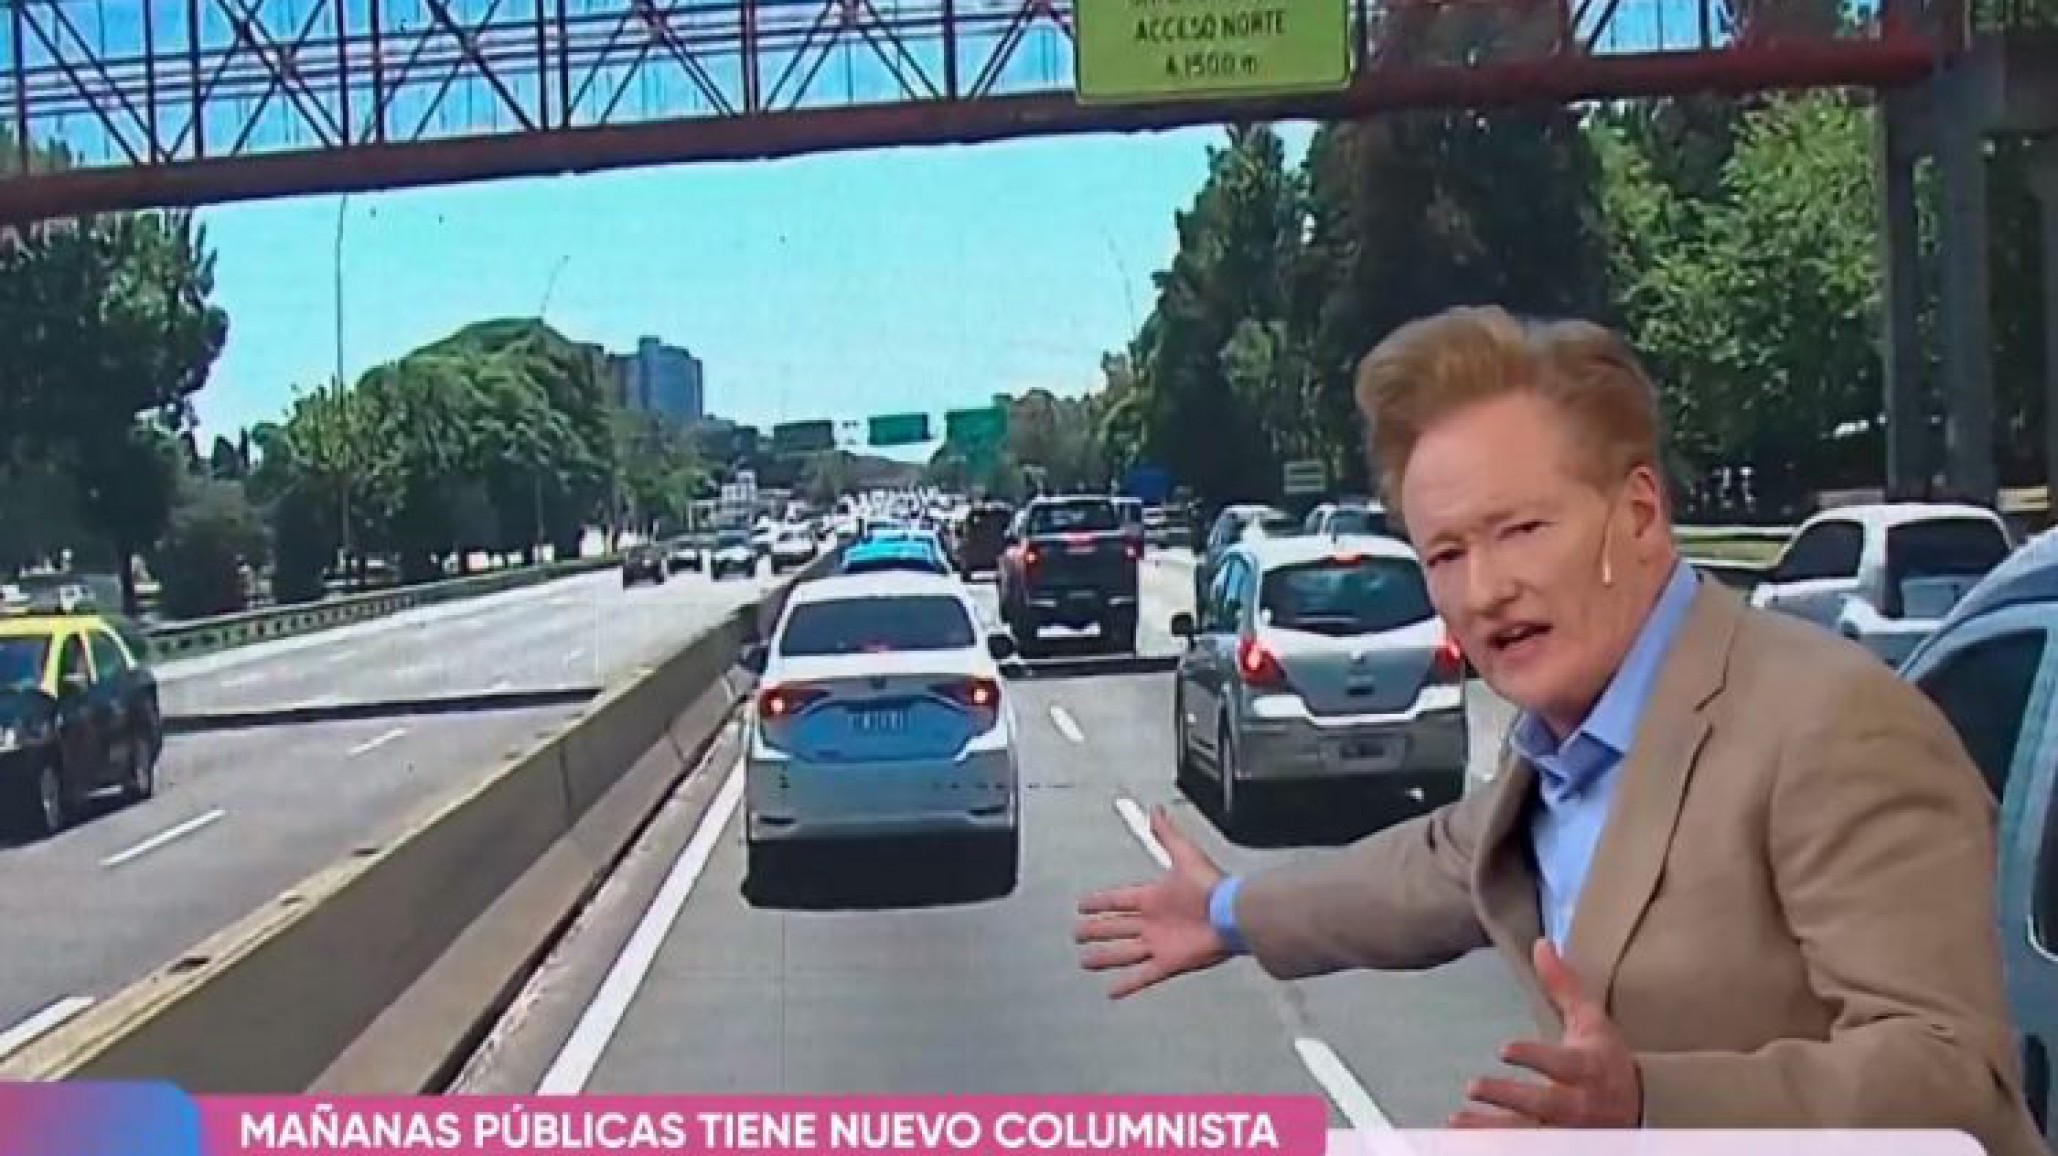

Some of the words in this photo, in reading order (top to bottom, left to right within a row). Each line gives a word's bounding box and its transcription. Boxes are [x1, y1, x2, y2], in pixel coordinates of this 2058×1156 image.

[1134, 13, 1217, 42] ACCESO
[1221, 10, 1287, 37] NORTE
[1165, 54, 1179, 76] A
[1184, 51, 1236, 77] 1500
